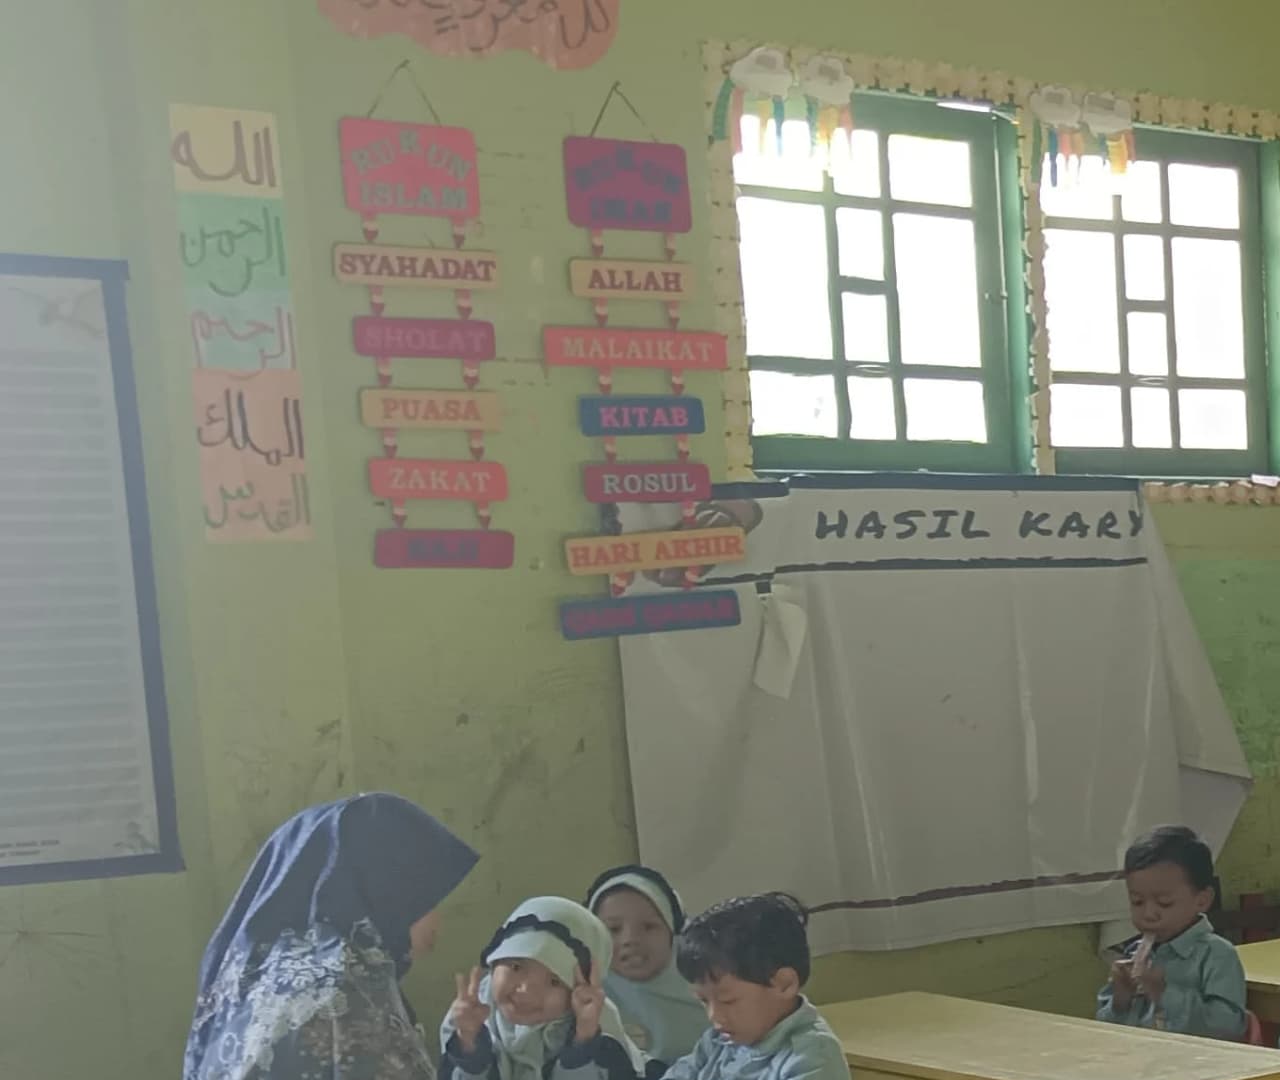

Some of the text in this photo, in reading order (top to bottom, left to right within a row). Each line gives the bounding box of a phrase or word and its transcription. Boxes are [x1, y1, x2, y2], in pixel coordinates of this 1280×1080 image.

[352, 129, 472, 181] RUKUN
[360, 181, 468, 210] ISLAM
[340, 253, 496, 282] SYAHADAT
[588, 268, 683, 293] ALLAH
[366, 325, 487, 354] SHOLAT
[562, 337, 713, 363] MALAIKAT
[381, 398, 483, 422] PUASA
[600, 406, 689, 428] KITAB
[389, 467, 490, 493] ZAKAT
[603, 473, 696, 495] ROSUL
[815, 510, 991, 539] HASIL
[570, 535, 745, 568] HARI AKHIR
